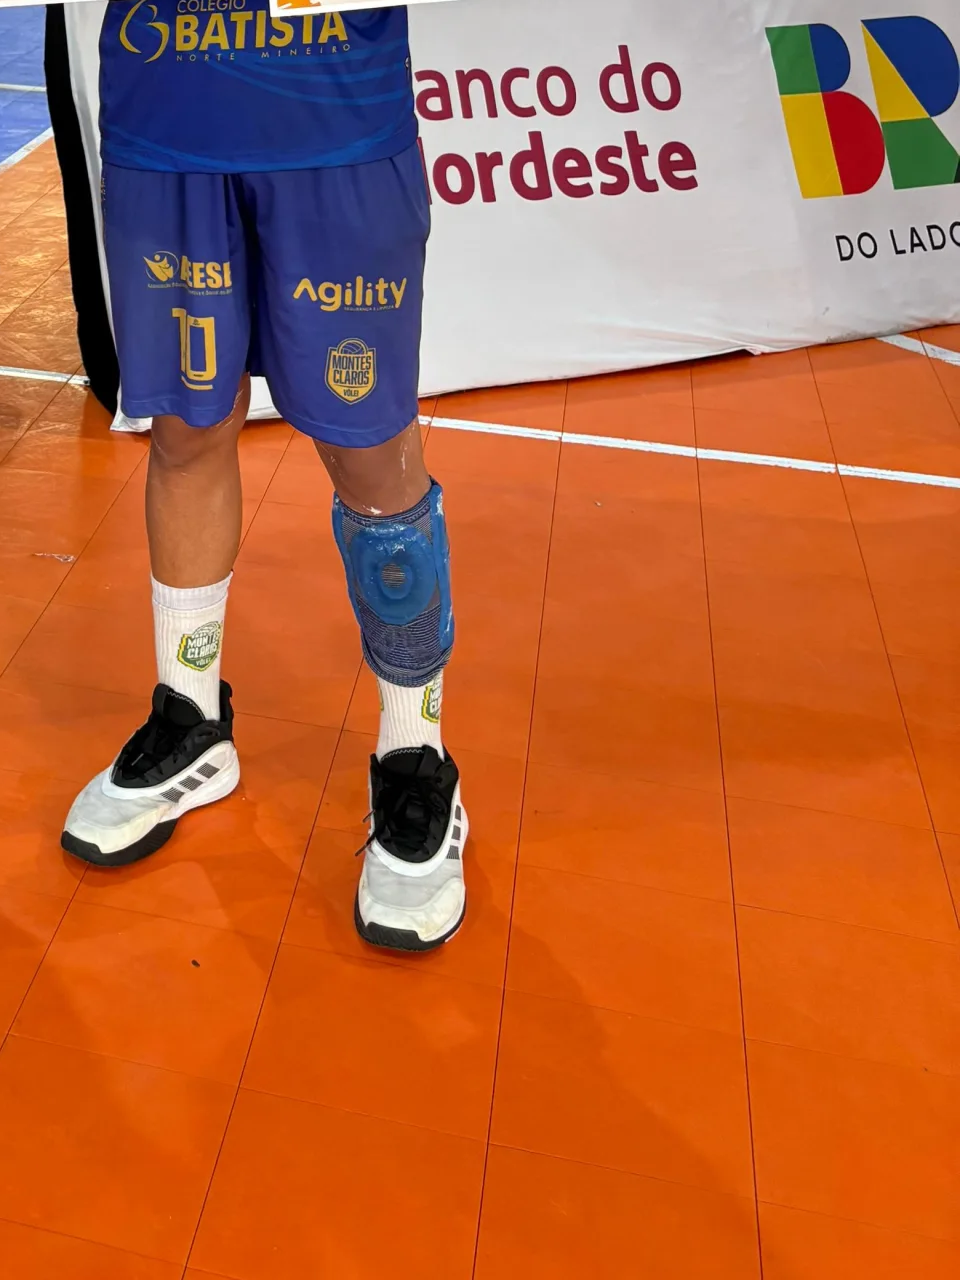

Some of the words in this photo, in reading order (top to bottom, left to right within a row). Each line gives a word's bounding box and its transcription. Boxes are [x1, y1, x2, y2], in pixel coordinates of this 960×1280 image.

[175, 10, 348, 52] BATISTA
[176, 52, 236, 62] NORTE
[261, 43, 351, 58] MINEIRO
[414, 65, 577, 121] anco
[599, 44, 682, 114] do
[417, 130, 699, 206] ordeste
[835, 232, 878, 262] DO
[293, 275, 407, 312] Agility
[172, 307, 217, 381] 10
[332, 355, 372, 370] MONTES
[333, 370, 370, 385] CLAROS
